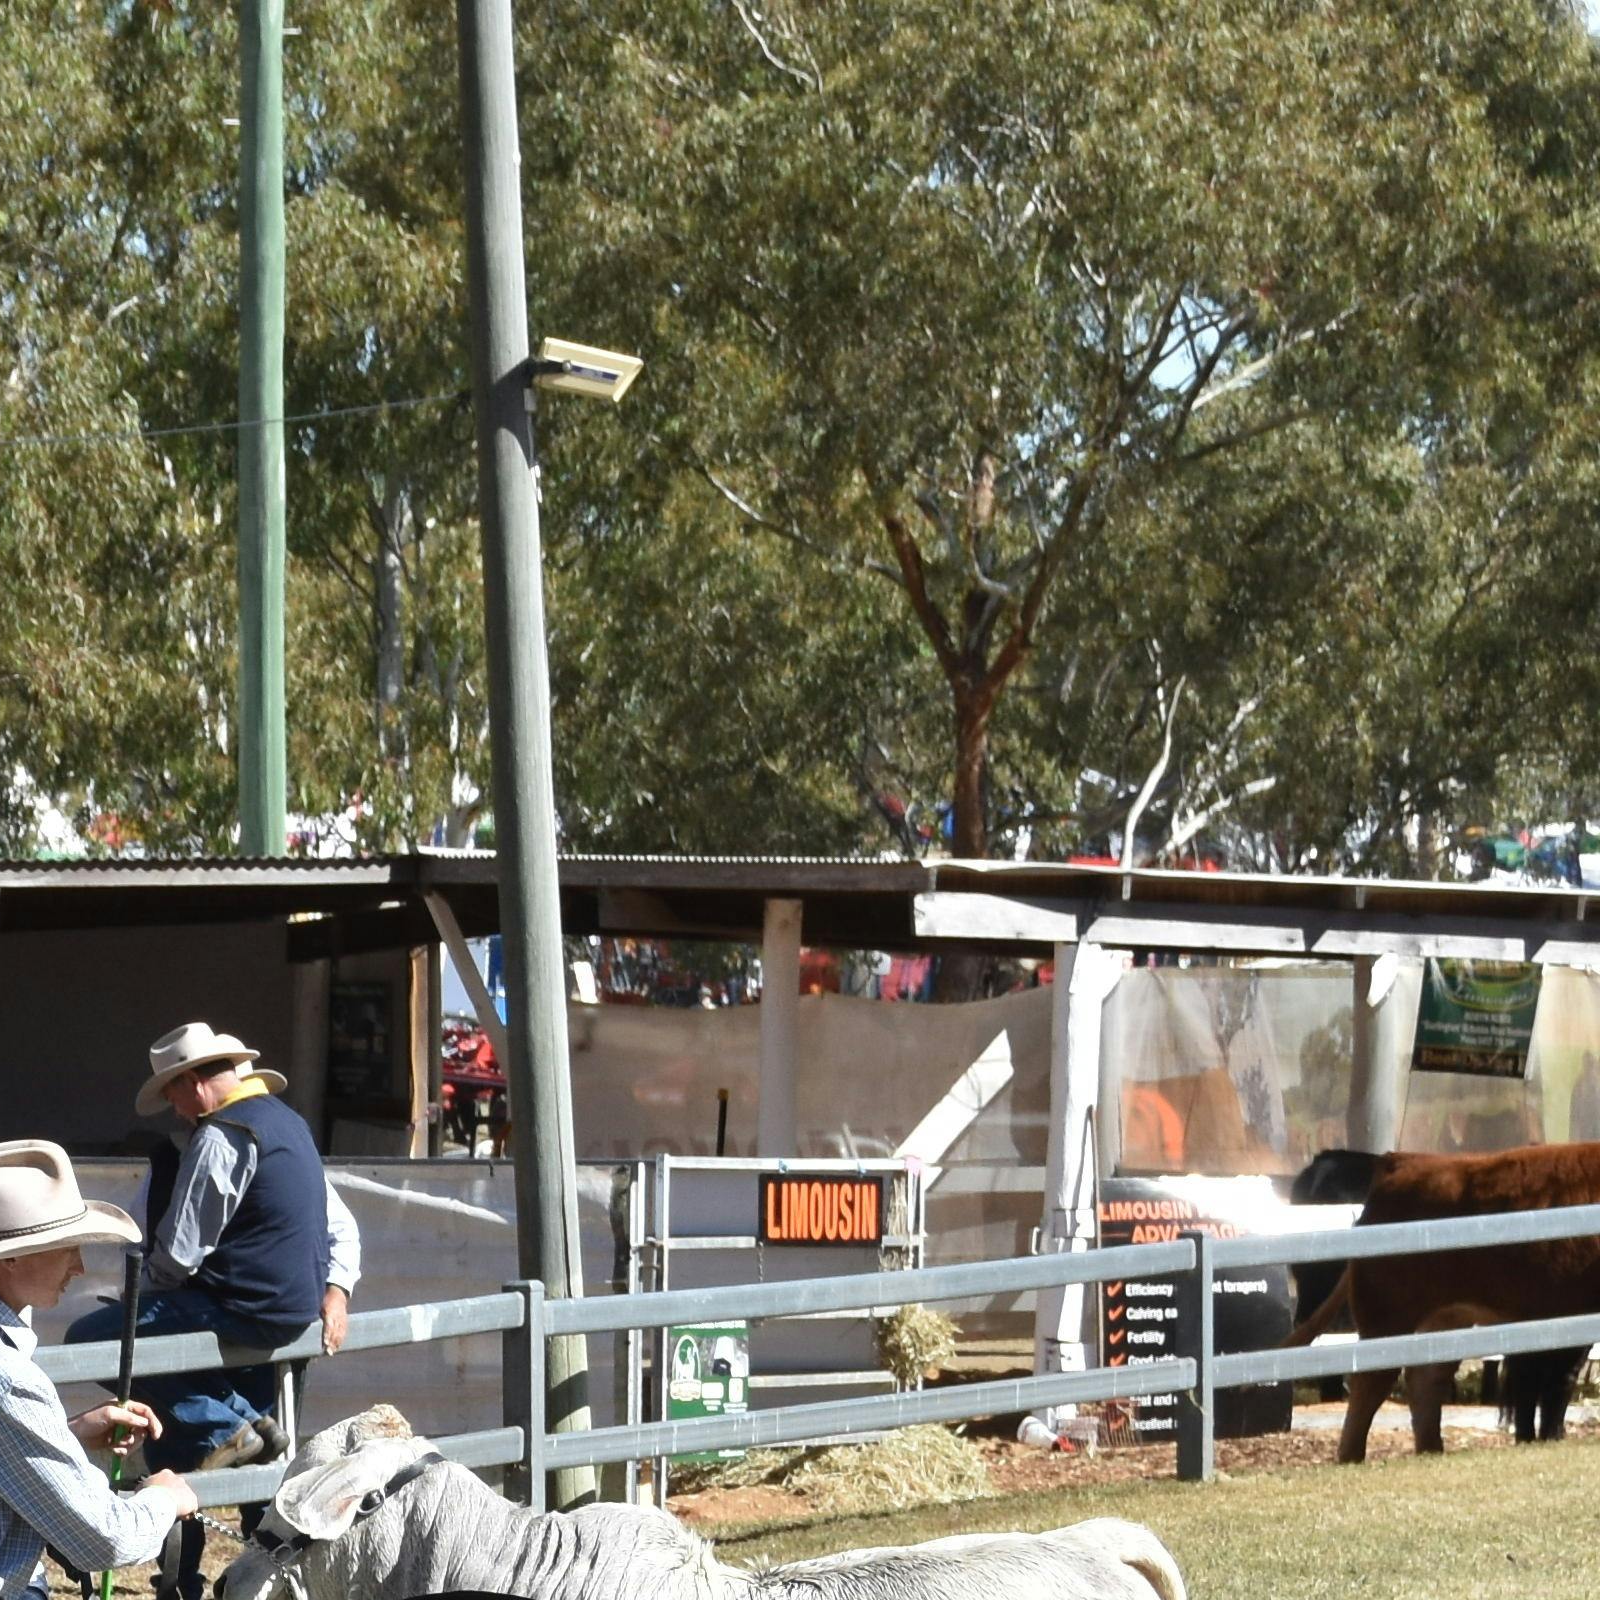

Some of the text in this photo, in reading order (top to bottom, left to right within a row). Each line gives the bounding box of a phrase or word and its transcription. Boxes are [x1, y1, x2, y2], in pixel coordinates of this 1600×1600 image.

[767, 1182, 877, 1240] LIMOUSIN
[1099, 1200, 1193, 1221] LIMOUSIN
[1125, 1283, 1174, 1298] Efficiency
[1126, 1307, 1164, 1322] Calving
[1127, 1331, 1166, 1346] Fertility
[1132, 1416, 1173, 1431] xcellent
